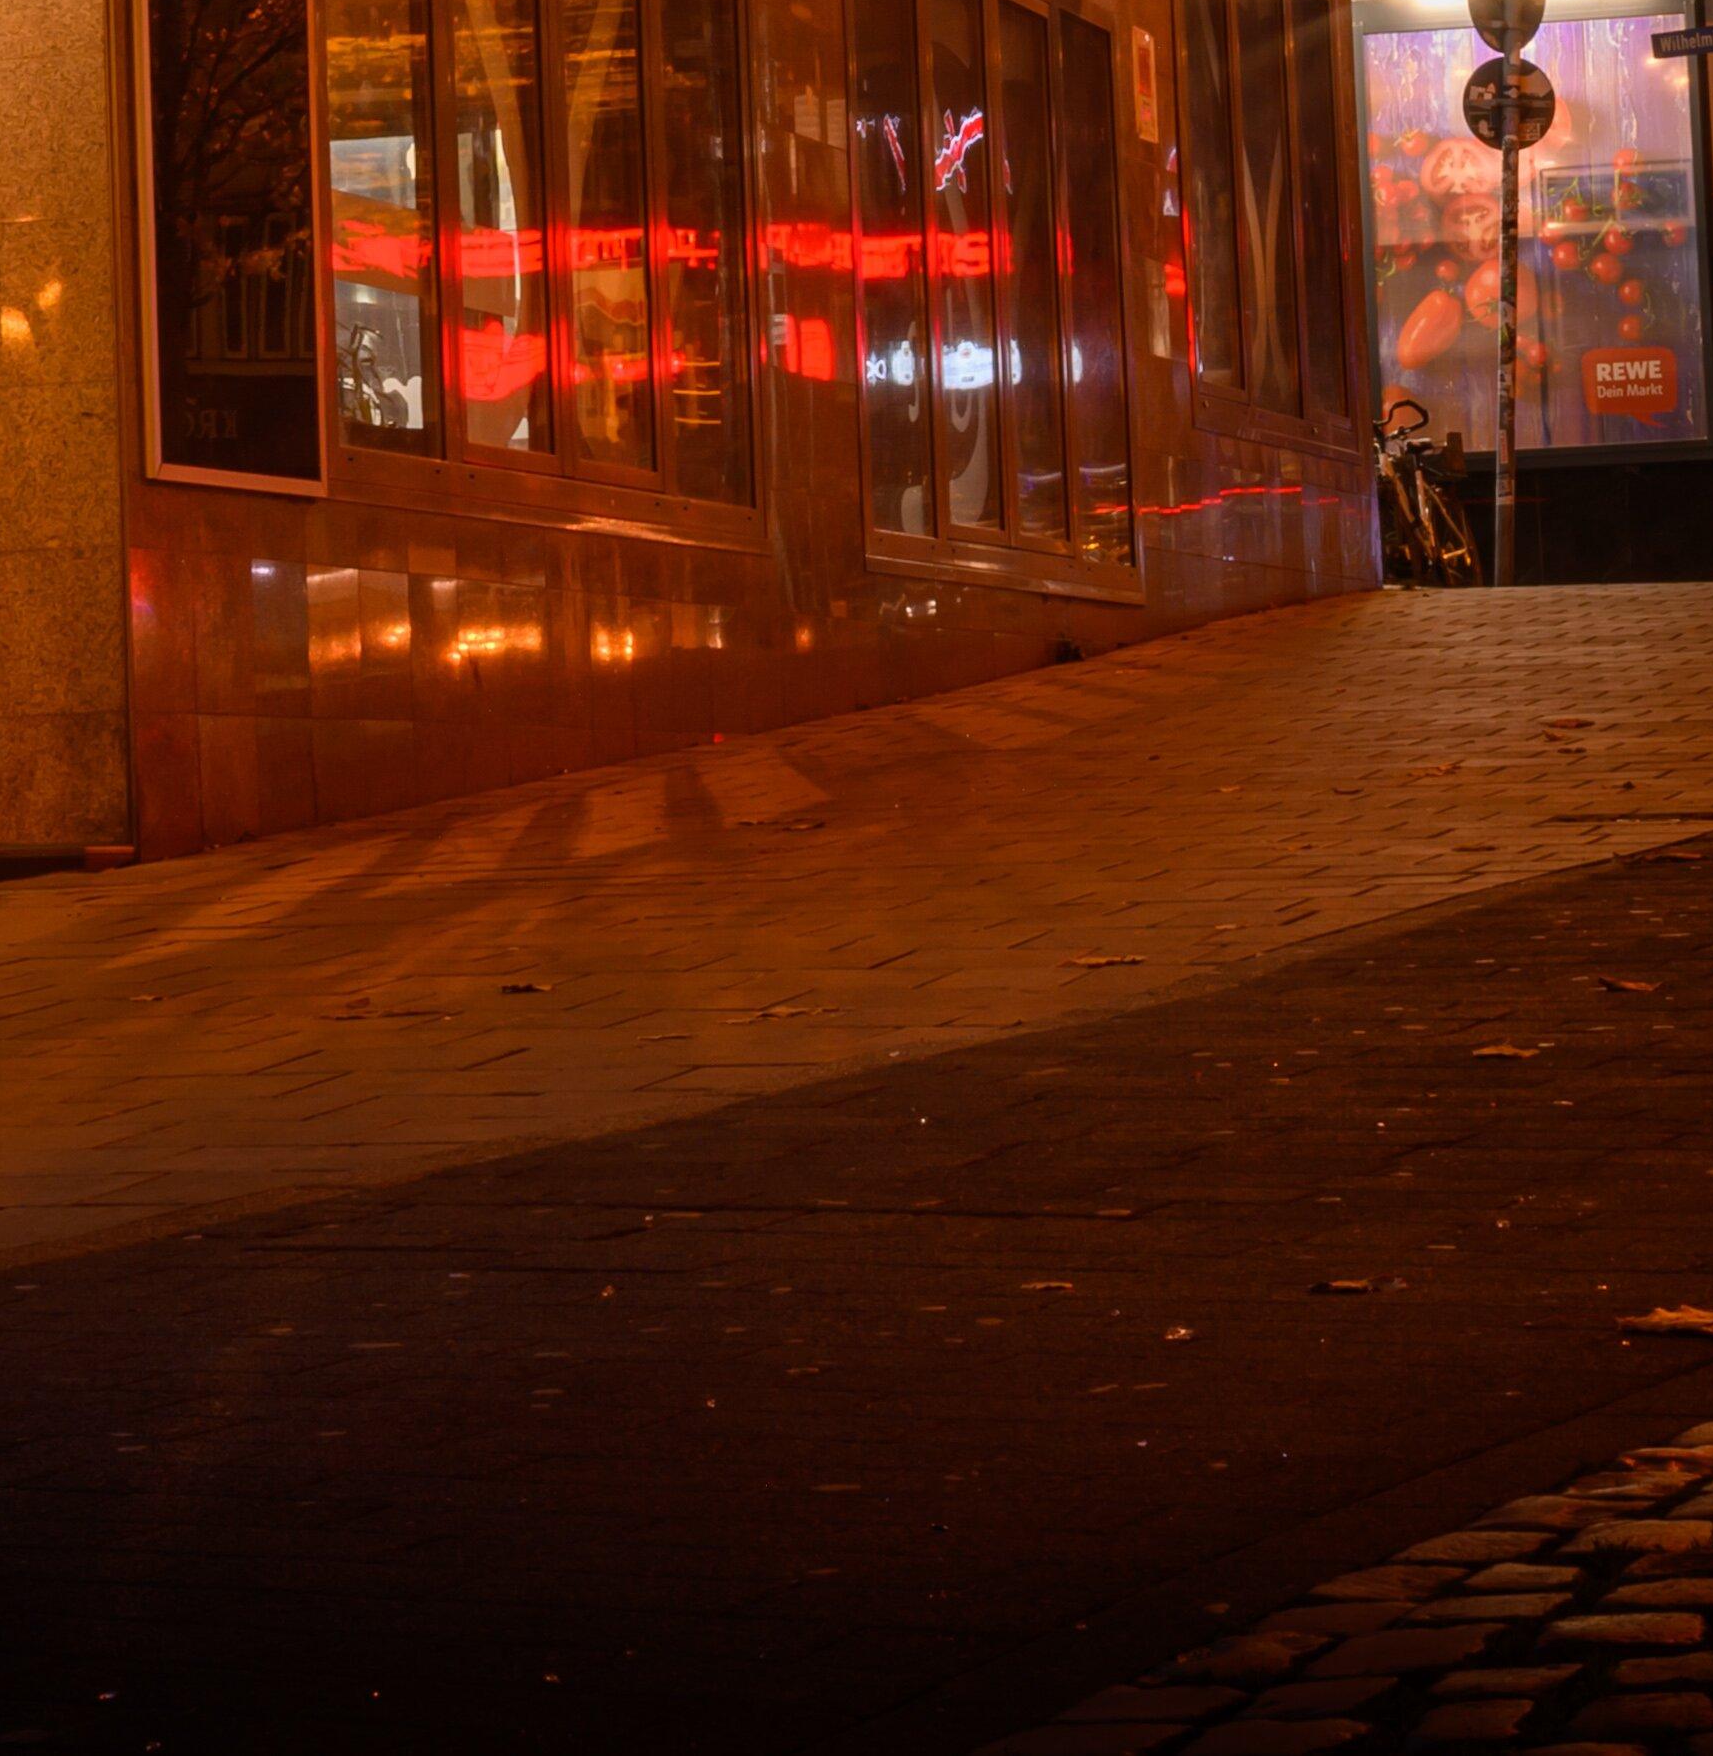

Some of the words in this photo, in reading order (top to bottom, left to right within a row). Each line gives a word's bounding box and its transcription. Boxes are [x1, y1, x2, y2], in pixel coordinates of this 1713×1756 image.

[1596, 359, 1663, 382] REWE
[1597, 385, 1624, 399] Dein
[1627, 383, 1664, 397] Markt
